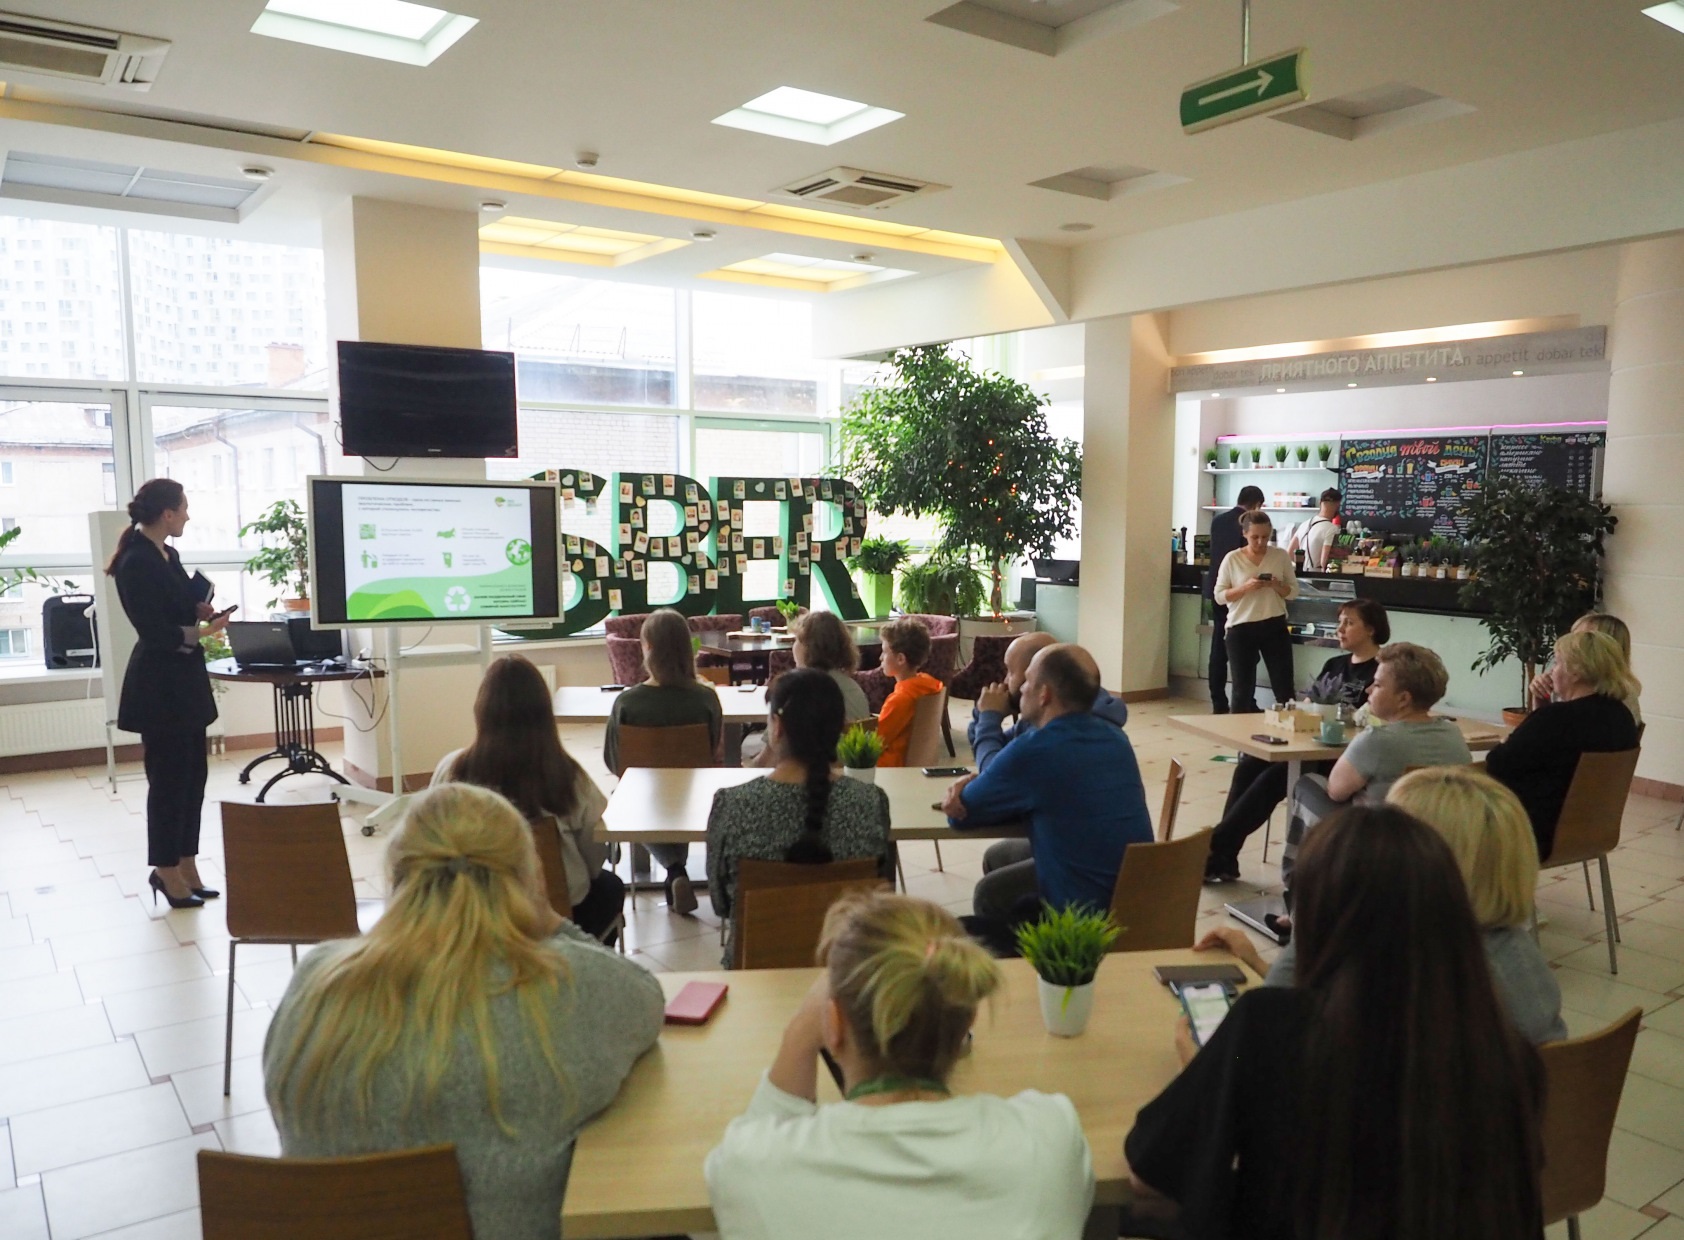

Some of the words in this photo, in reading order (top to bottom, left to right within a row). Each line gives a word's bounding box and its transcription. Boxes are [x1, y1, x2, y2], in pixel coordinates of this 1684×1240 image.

[1262, 356, 1360, 379] ПРИЯТНОГО
[1365, 347, 1464, 371] АППЕТИТА
[1476, 349, 1529, 367] appetit
[1536, 347, 1574, 361] dobar
